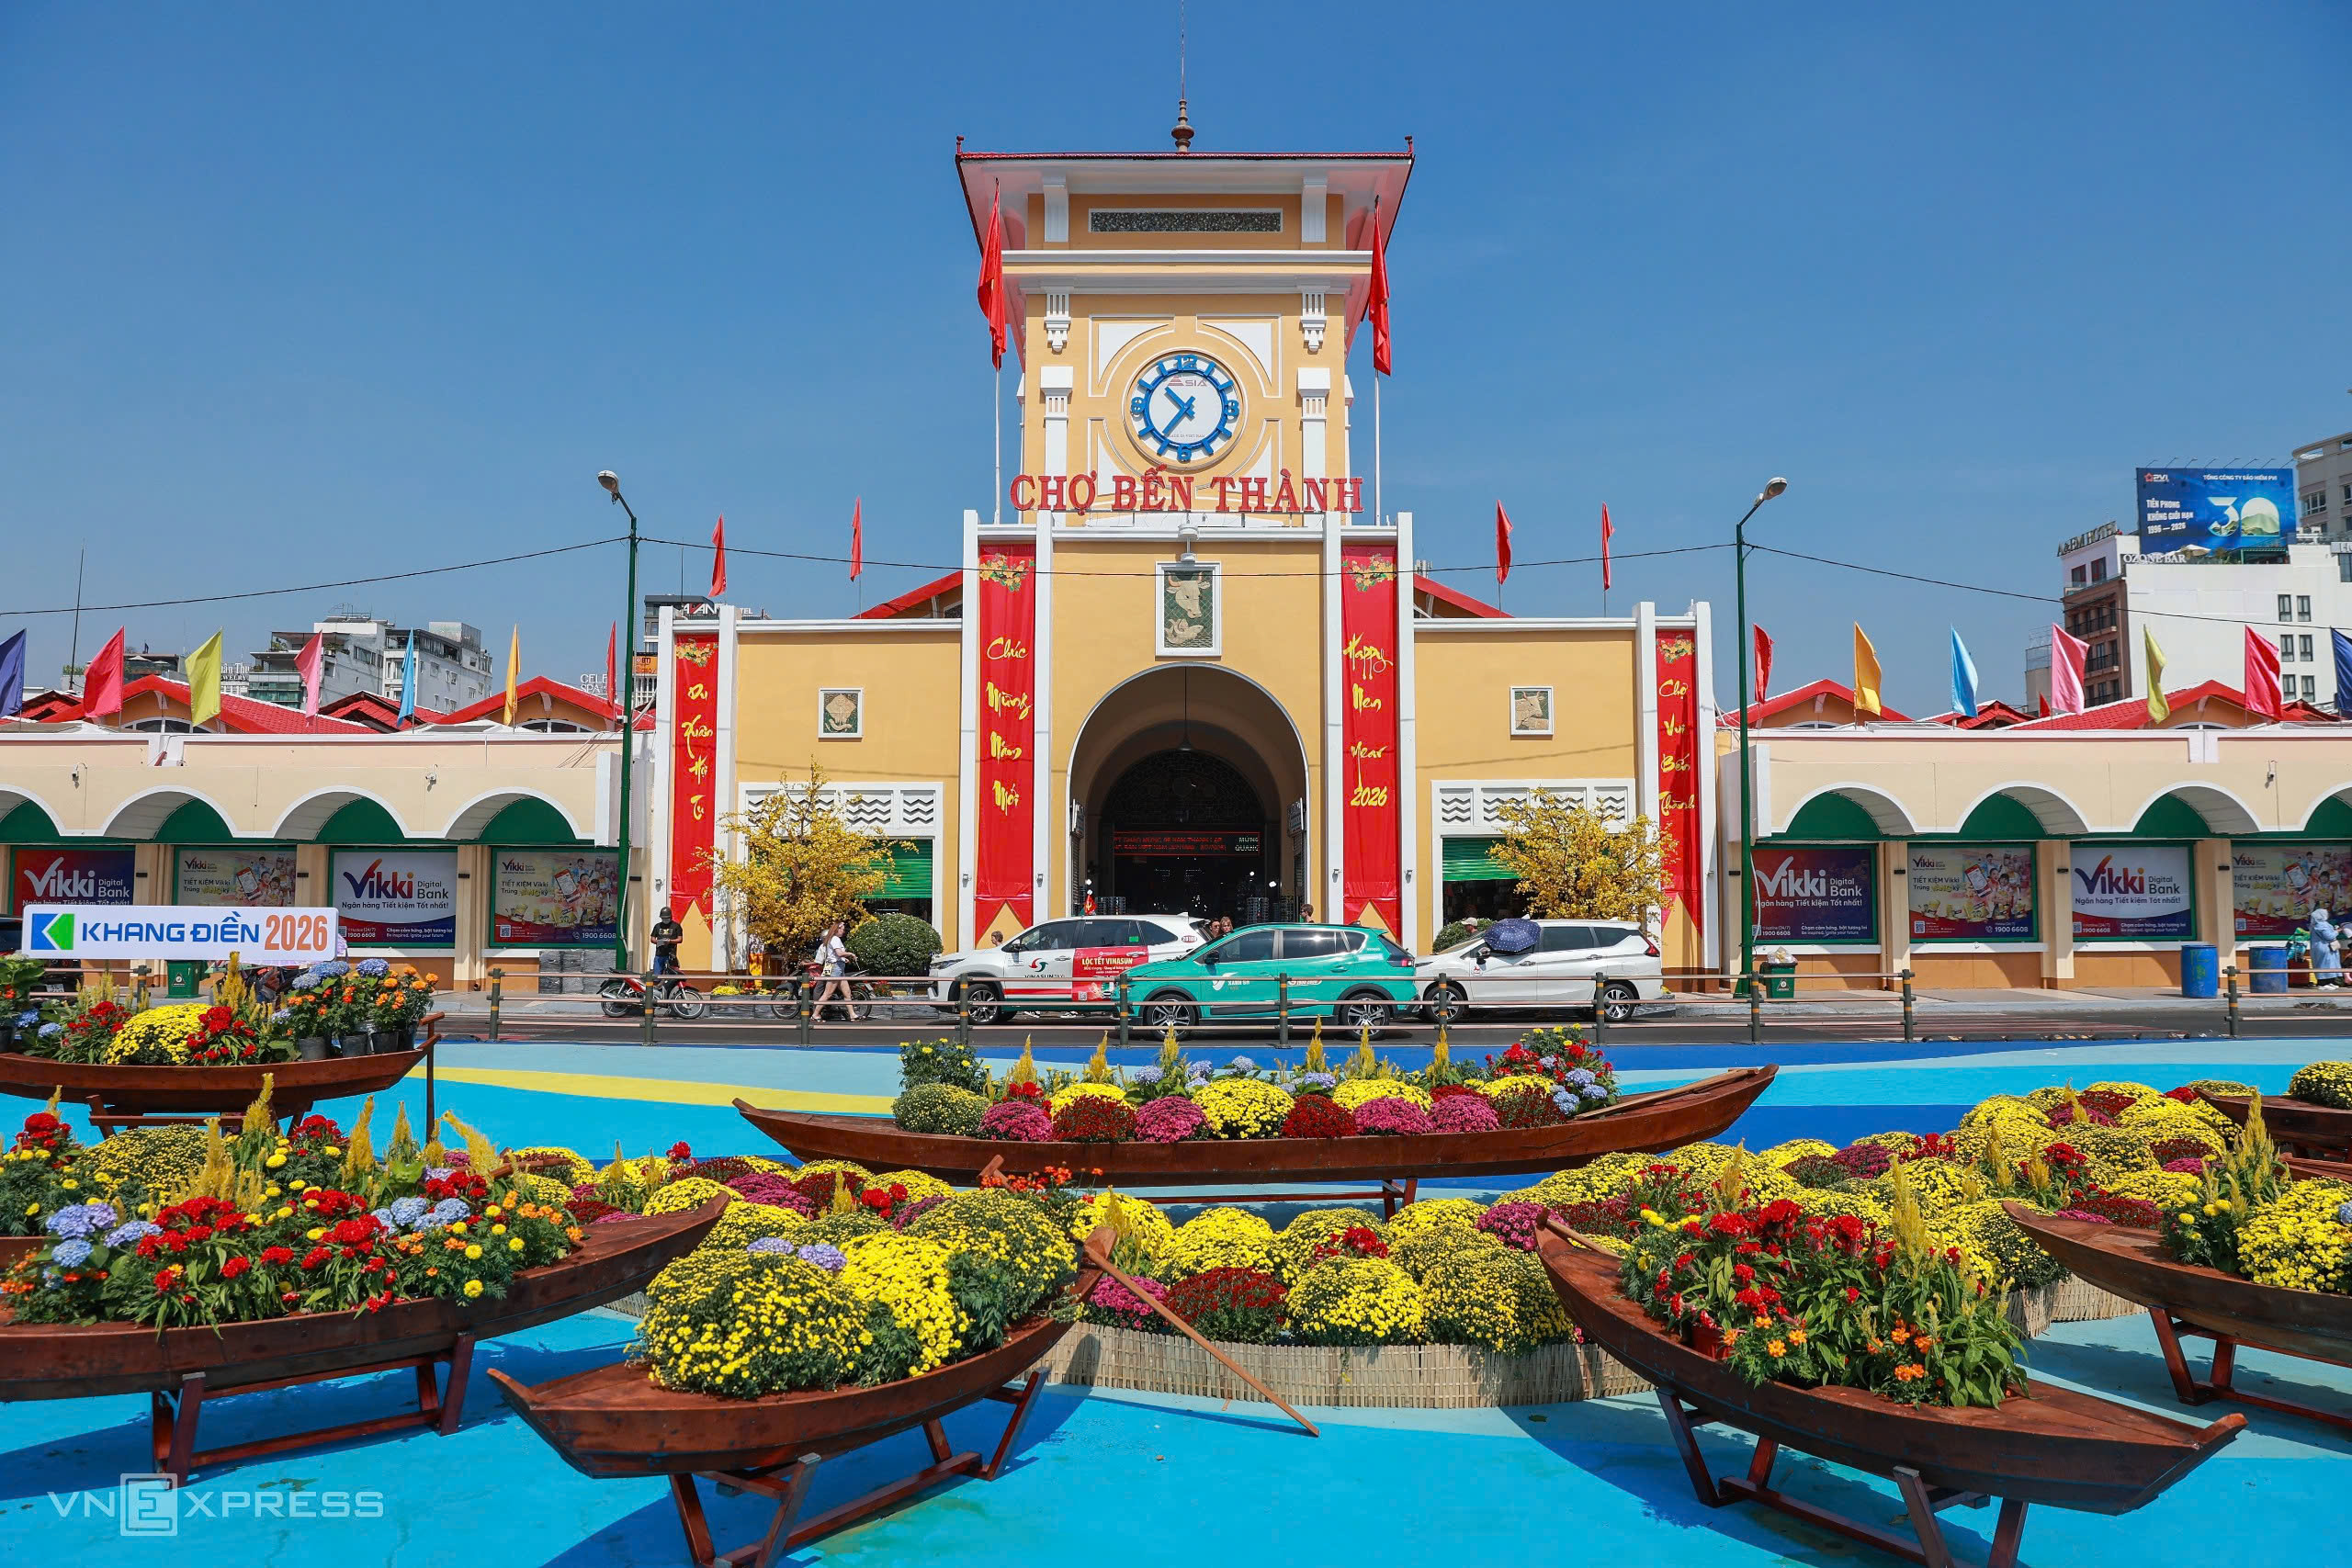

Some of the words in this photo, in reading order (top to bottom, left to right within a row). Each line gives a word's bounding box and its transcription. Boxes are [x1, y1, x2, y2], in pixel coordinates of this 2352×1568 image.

[1175, 355, 1198, 370] 12
[1131, 397, 1145, 413] 9
[1224, 400, 1239, 417] 3
[1177, 444, 1192, 461] 6
[1010, 469, 1098, 515] CHỢ
[1112, 463, 1193, 511] BẾN
[1211, 468, 1364, 513] THÀNH
[2165, 553, 2187, 563] BAR
[987, 637, 1029, 660] Chúc
[1342, 631, 1394, 681] Happy
[688, 683, 708, 701] Du
[1658, 679, 1689, 700] Chợ
[986, 682, 1034, 720] Mừng
[1663, 712, 1686, 736] Vui
[681, 714, 714, 760] Xuân
[990, 731, 1023, 764] Năm
[1351, 741, 1388, 787] Year
[1661, 753, 1691, 773] Bến
[992, 780, 1020, 816] Mới
[1351, 785, 1388, 807] 2026
[1658, 791, 1695, 817] Thành
[184, 856, 207, 869] Vikki
[502, 859, 525, 872] Vikki
[1912, 855, 1935, 868] Vikki
[2233, 852, 2256, 865] Vikki
[23, 856, 96, 897] Vikki
[98, 878, 123, 887] Digital
[343, 858, 414, 899] Vikki
[1756, 856, 1826, 897] Vikki
[1829, 878, 1855, 886] Digital
[2074, 854, 2144, 894] Vikki
[2148, 875, 2173, 884] Digital
[97, 886, 130, 897] Bank
[417, 881, 442, 889] Digital
[417, 888, 449, 899] Bank
[1830, 886, 1862, 897] Bank
[2149, 883, 2180, 895] Bank
[342, 901, 361, 909] Ngân
[362, 901, 380, 909] hàng
[382, 901, 396, 909] Tiết
[398, 901, 415, 909] kiệm
[417, 901, 429, 909] Tốt
[430, 901, 449, 909] nhất!
[1776, 898, 1793, 908] hàng
[1795, 898, 1810, 908] Tiết
[1811, 898, 1828, 908] kiệm
[1830, 898, 1842, 908] Tốt
[1843, 898, 1862, 908] nhất!
[2075, 897, 2094, 905] Ngân
[2095, 897, 2113, 905] hàng
[2115, 897, 2129, 905] Tiết
[2131, 897, 2148, 905] kiệm
[2149, 897, 2161, 905] Tốt
[2162, 897, 2181, 905] nhất!
[82, 922, 185, 942] KHANG
[190, 910, 260, 942] ĐIỀN
[264, 915, 328, 951] 2026
[1093, 955, 1104, 964] TẾT
